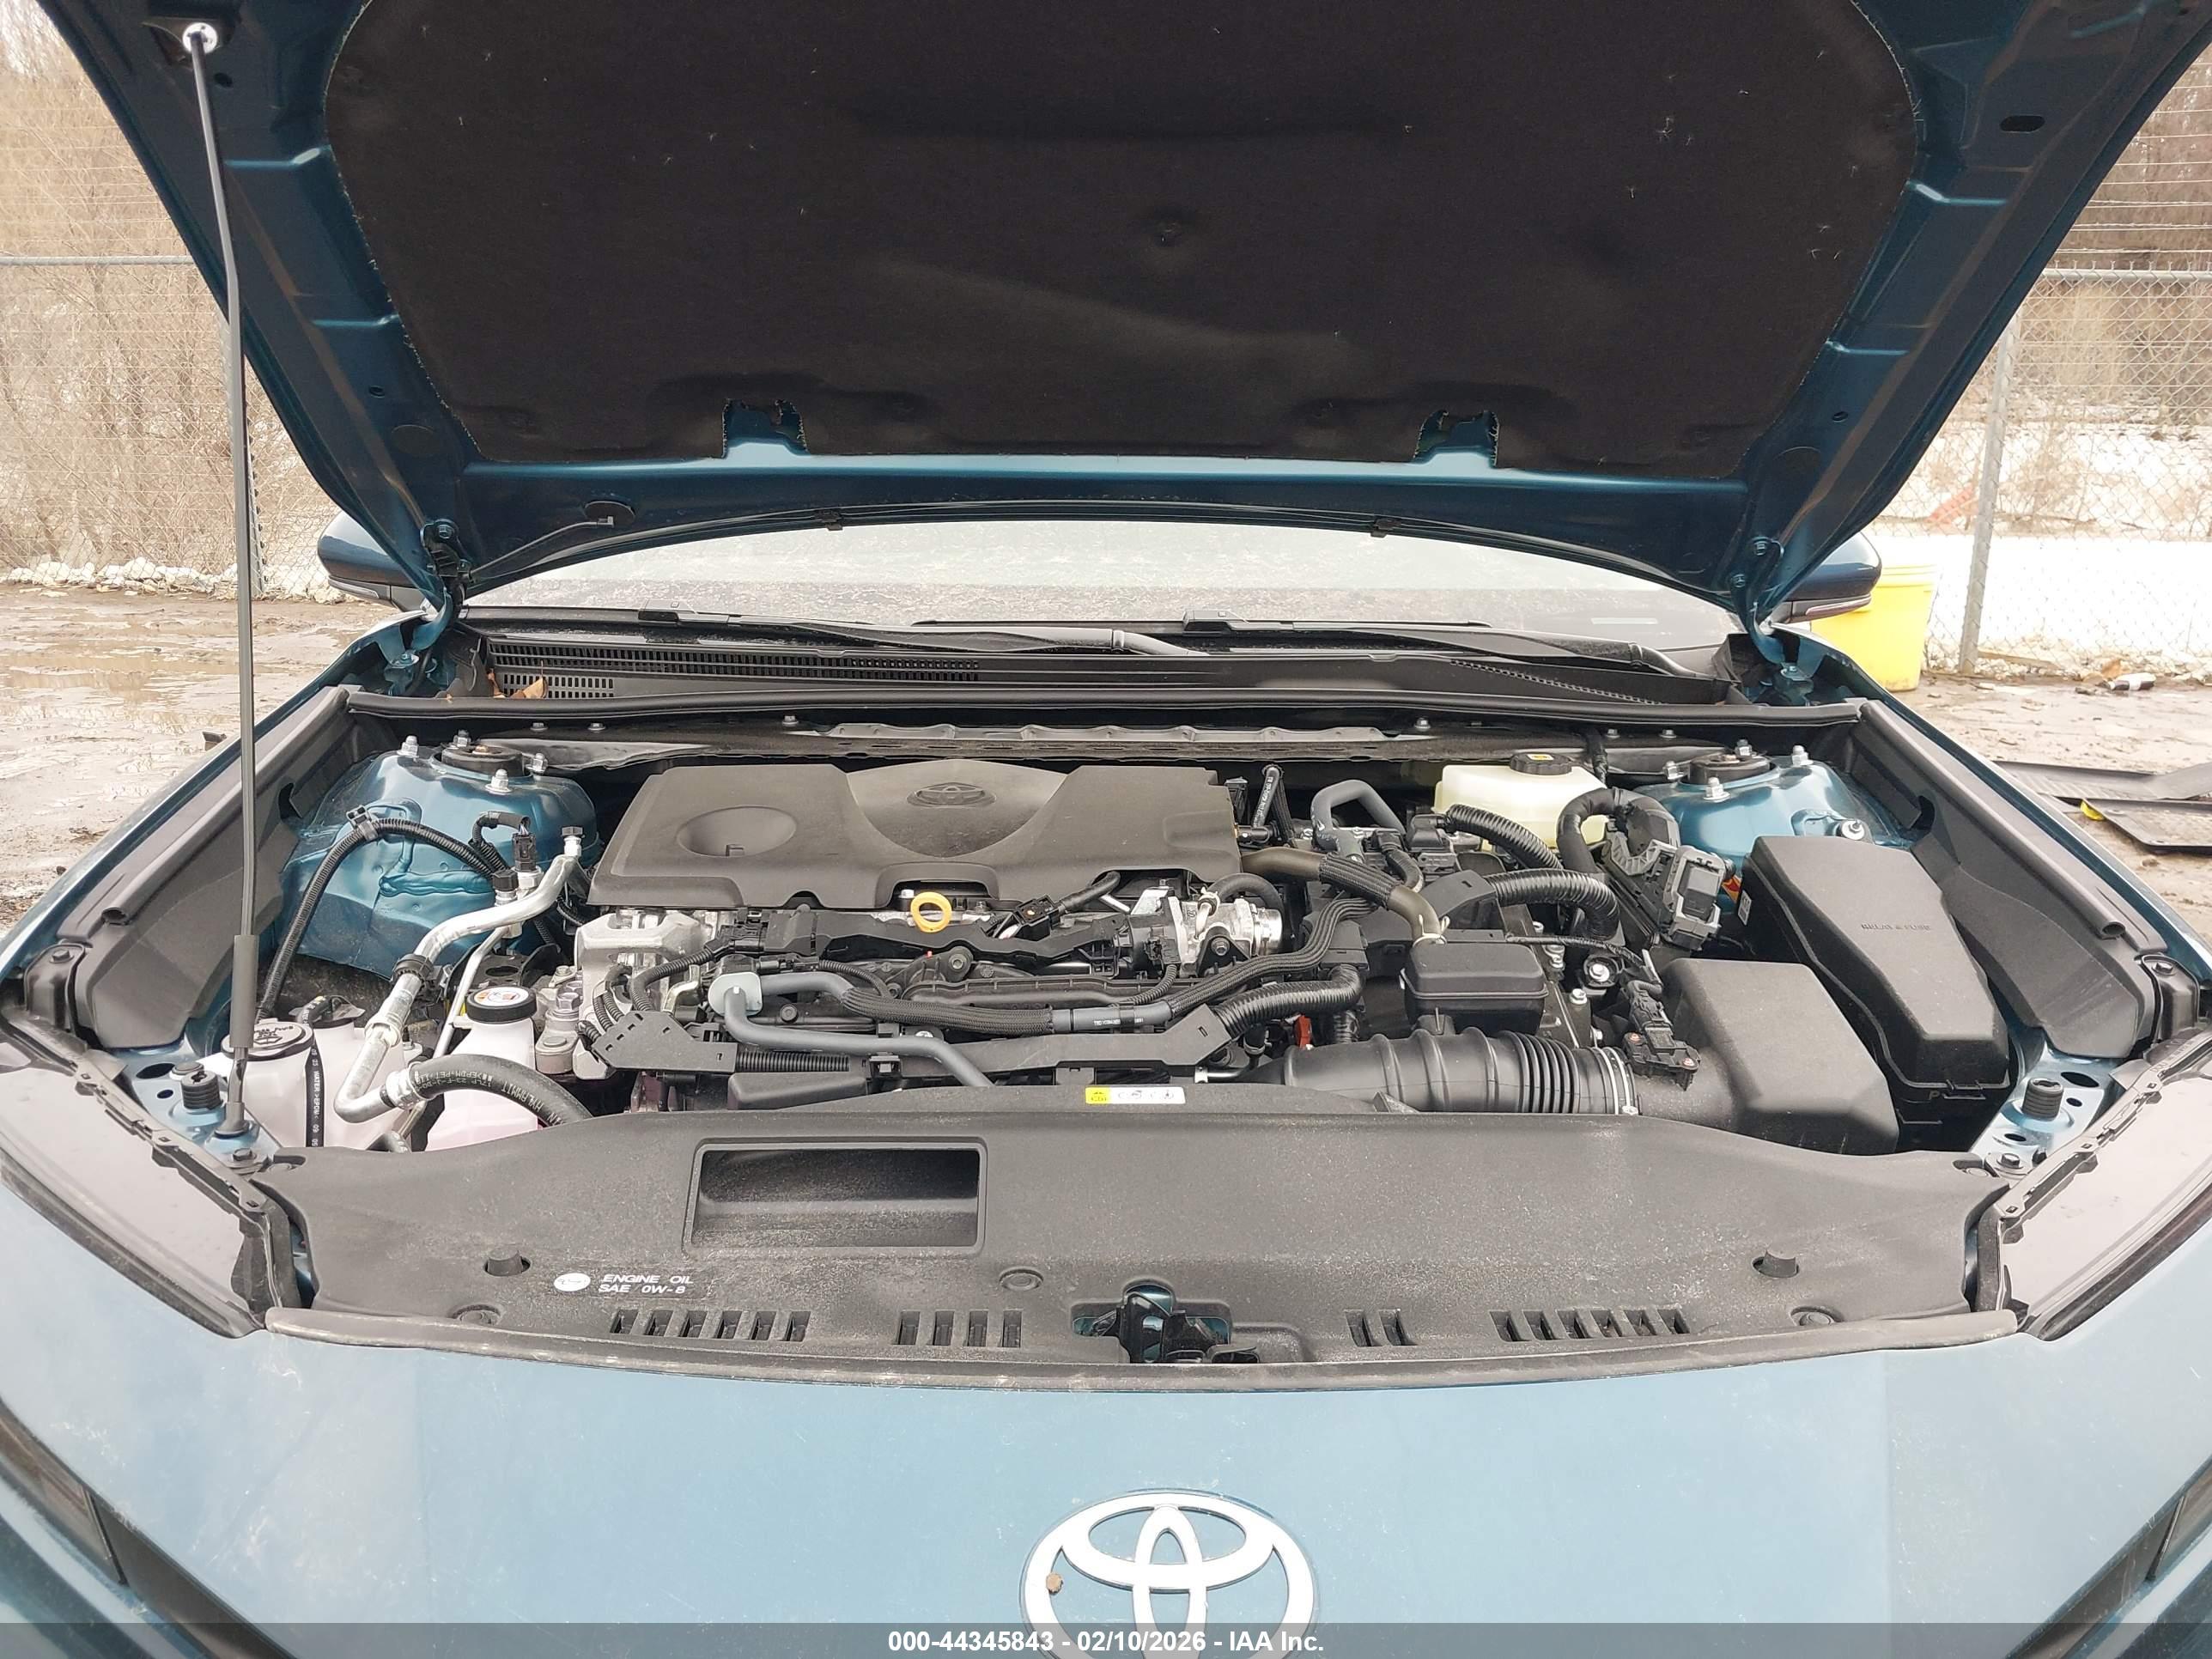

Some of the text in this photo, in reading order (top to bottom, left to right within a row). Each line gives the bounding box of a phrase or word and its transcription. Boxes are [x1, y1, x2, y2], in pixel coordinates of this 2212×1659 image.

[603, 1273, 694, 1285] ENGINE OIL
[598, 1284, 686, 1294] SAE 0W-8
